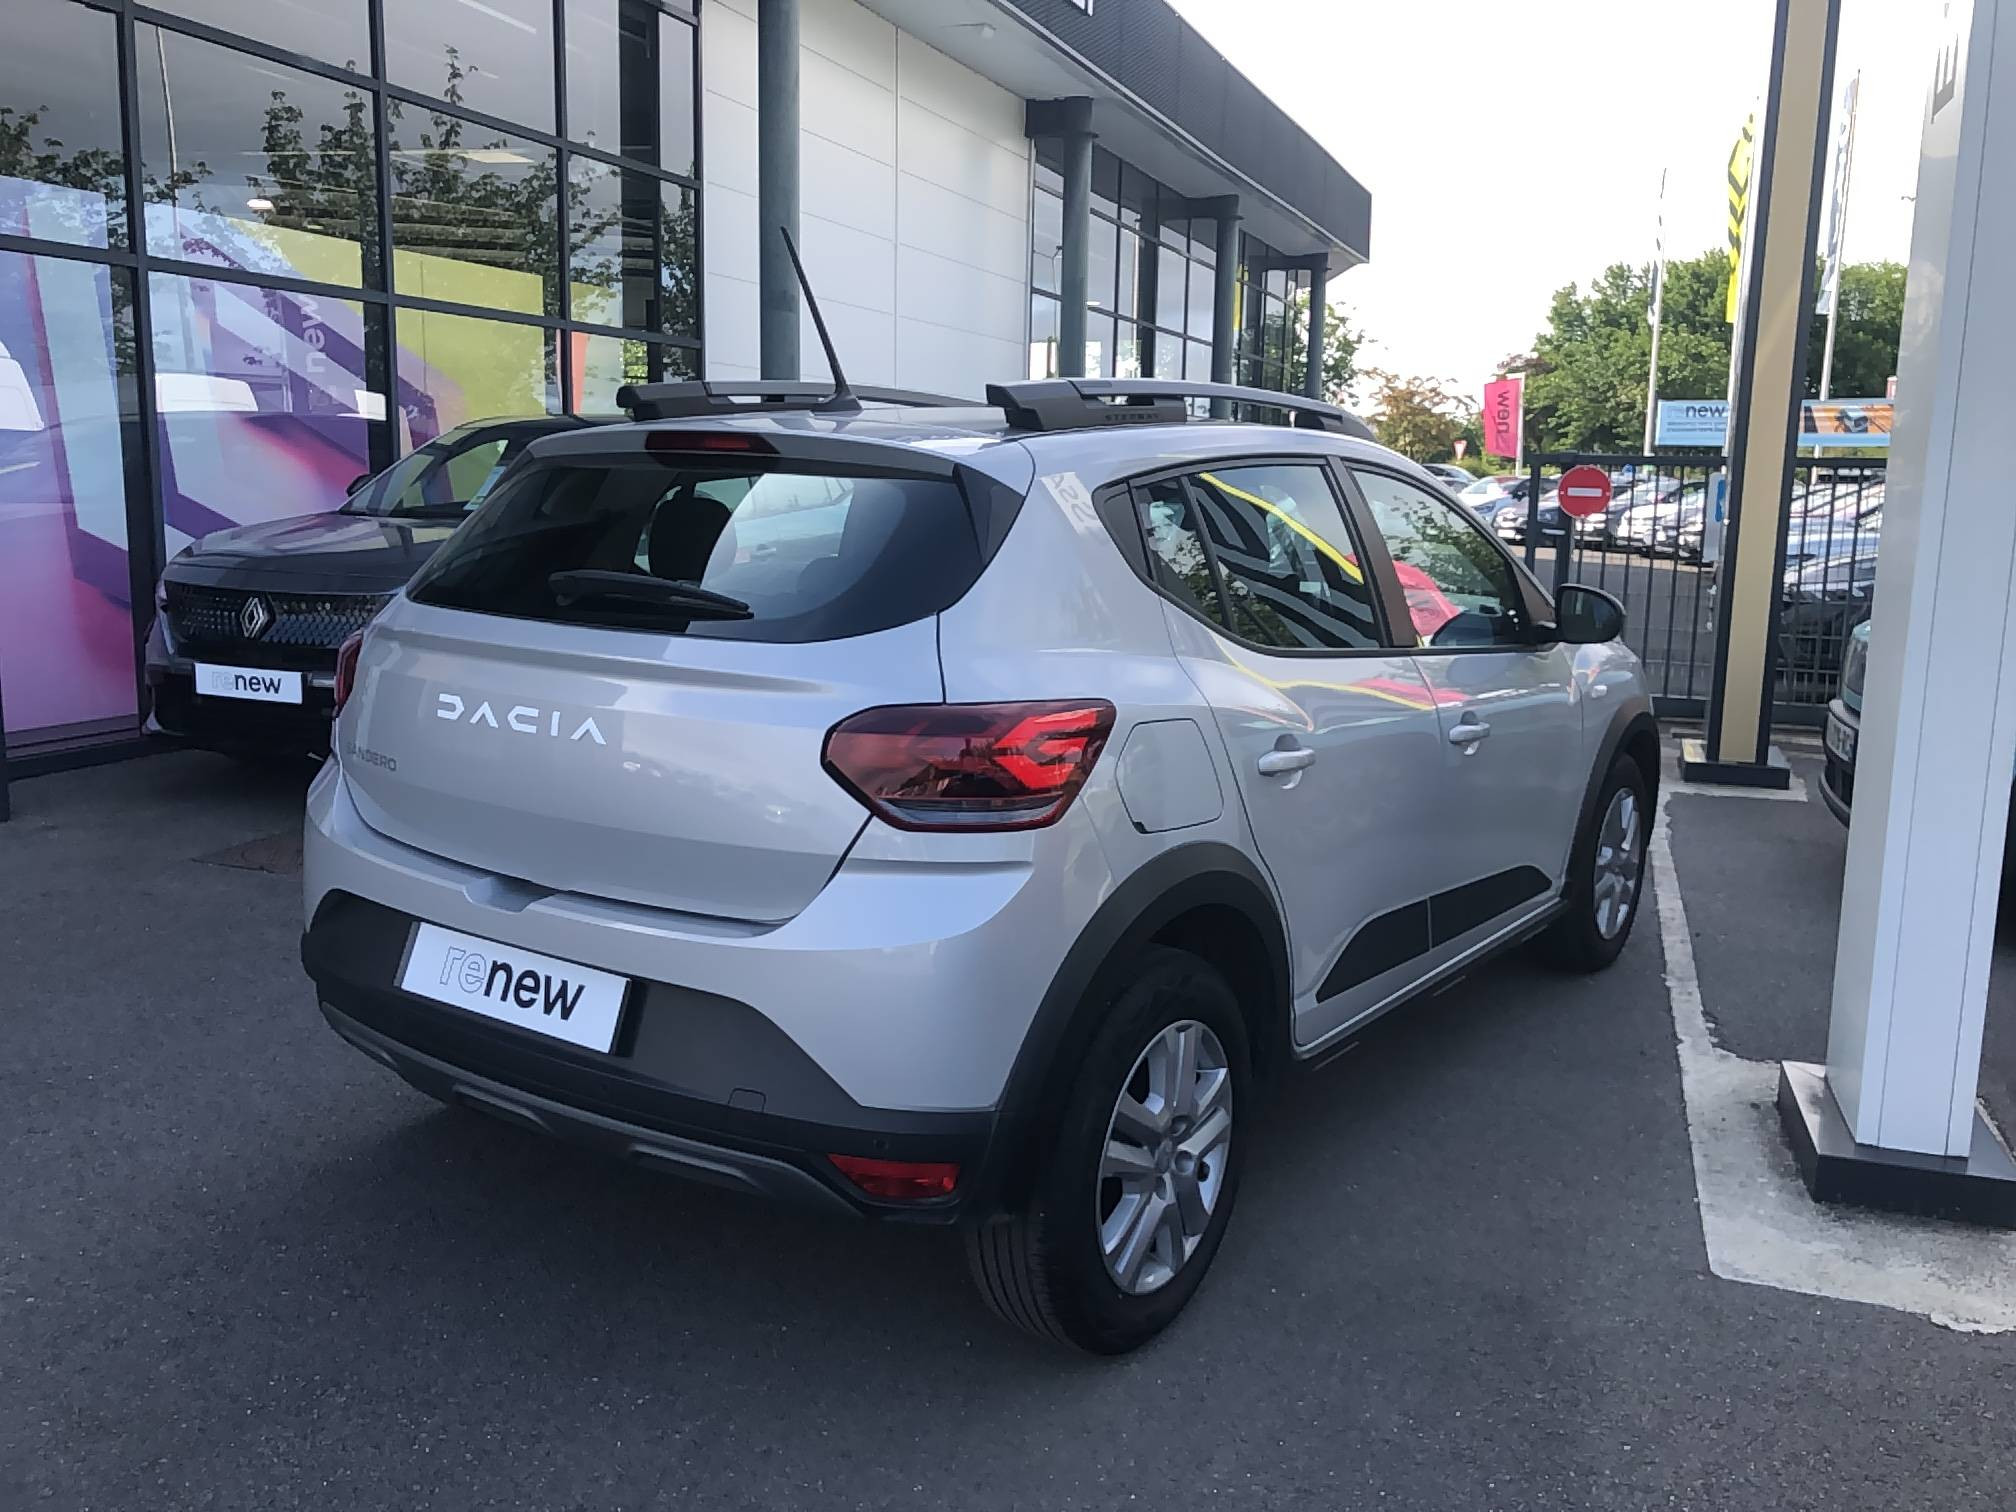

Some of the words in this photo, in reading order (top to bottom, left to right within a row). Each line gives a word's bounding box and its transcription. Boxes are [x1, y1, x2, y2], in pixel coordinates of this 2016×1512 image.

[212, 671, 282, 694] renew
[437, 693, 607, 745] DACIA
[439, 946, 586, 1021] renew
